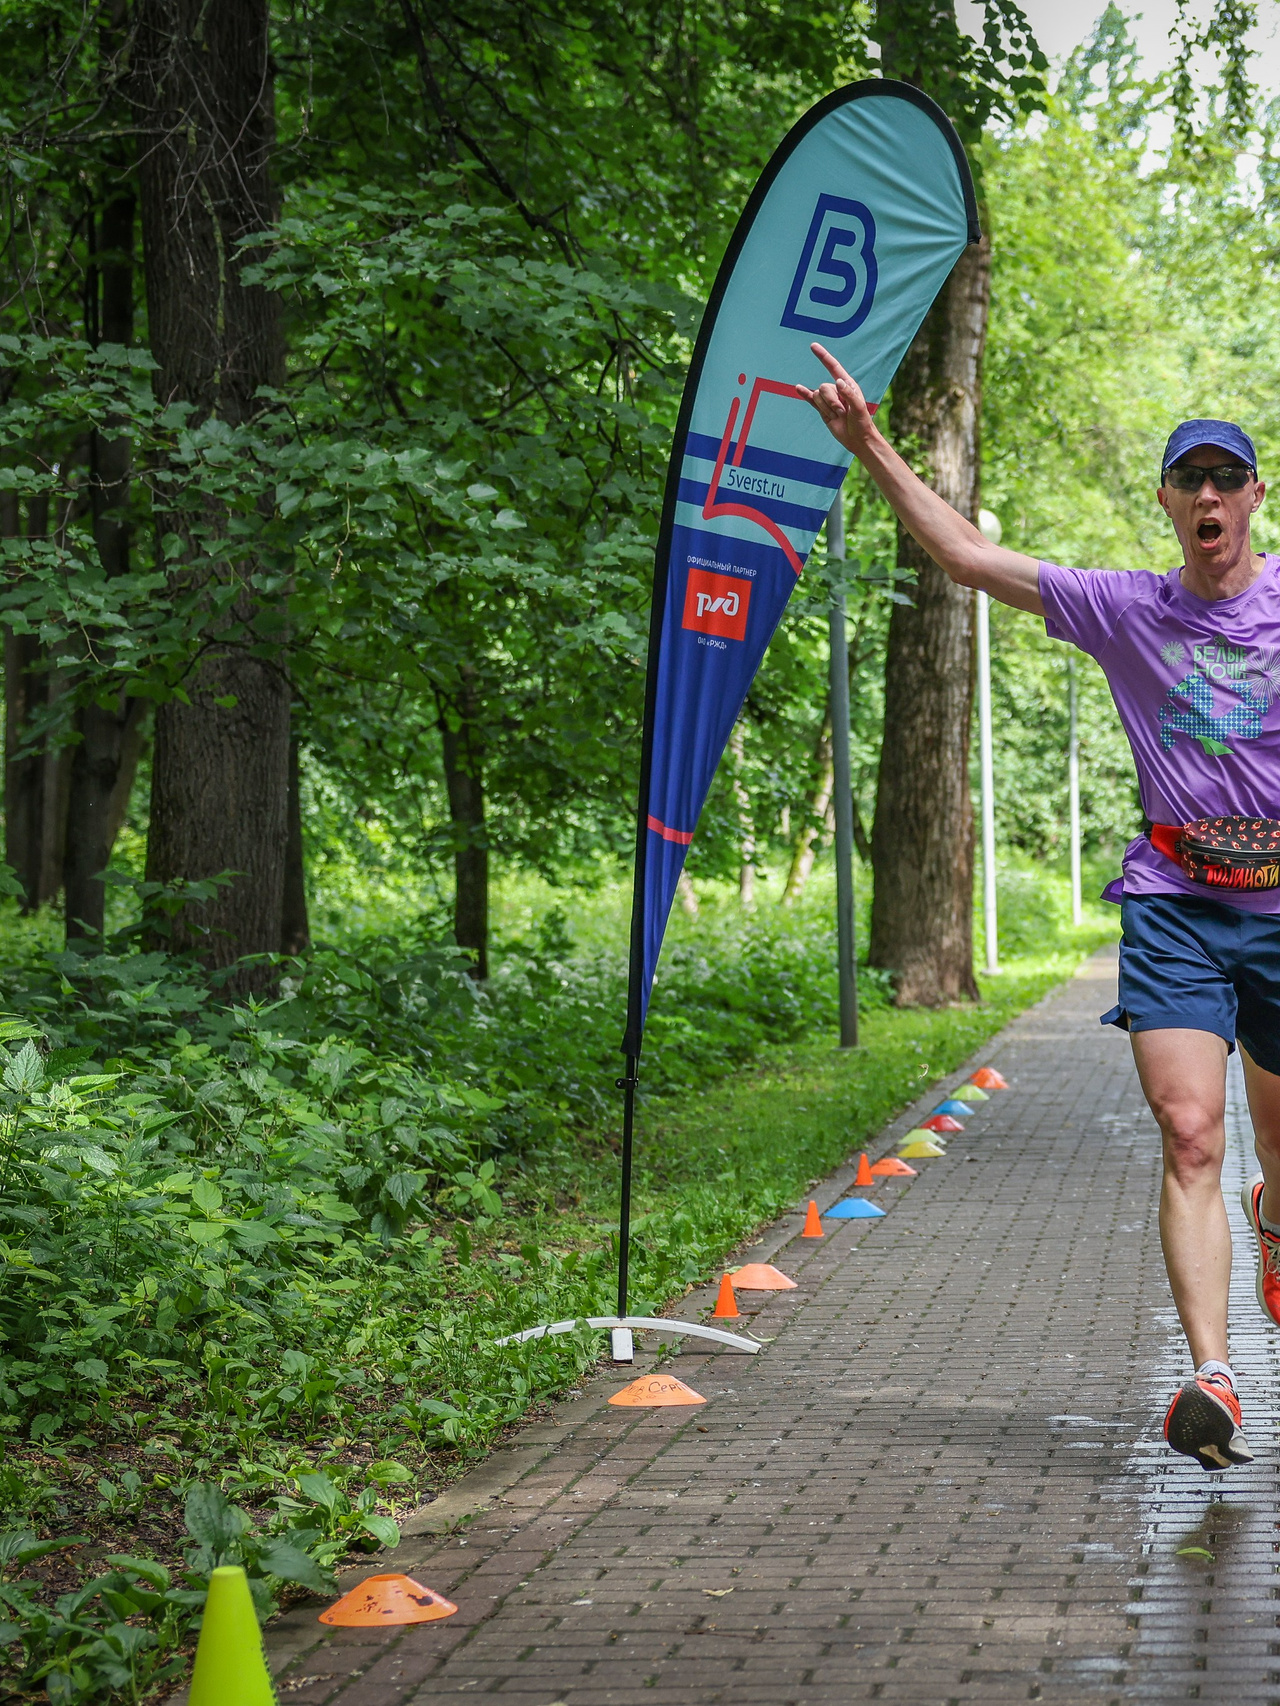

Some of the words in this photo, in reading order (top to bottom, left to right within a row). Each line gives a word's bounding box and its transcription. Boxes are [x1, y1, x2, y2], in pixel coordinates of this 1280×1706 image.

[727, 468, 785, 498] 5verst.ru
[686, 555, 732, 572] ОФИЦИАЛЬНЫЙ
[732, 565, 757, 577] ПАРТНЕР
[1194, 645, 1247, 663] БЕЛЫЕ
[1194, 662, 1247, 680] НОЧИ
